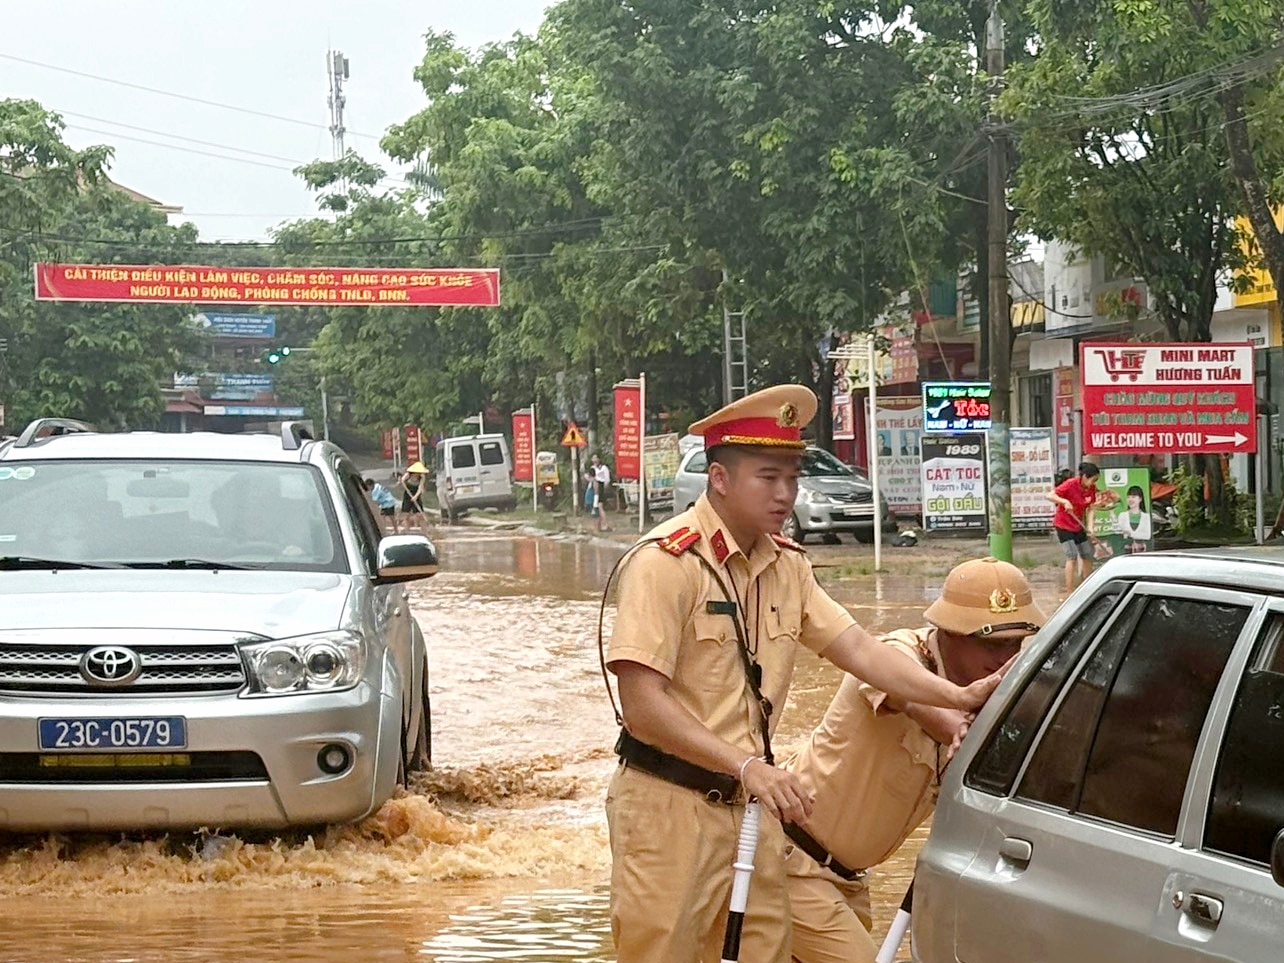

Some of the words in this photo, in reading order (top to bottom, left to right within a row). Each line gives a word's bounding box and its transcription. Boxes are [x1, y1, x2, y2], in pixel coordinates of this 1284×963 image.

[1161, 350, 1194, 363] MINI
[1197, 350, 1236, 363] MART
[1156, 368, 1203, 381] HƯƠNG
[1206, 366, 1241, 381] TUẤN
[1091, 432, 1154, 448] WELCOME
[1157, 432, 1174, 447] TO
[1178, 432, 1202, 447] YOU
[945, 445, 980, 456] 1989
[926, 465, 952, 481] CẮT
[932, 483, 955, 492] Nam
[55, 719, 171, 747] 23C-0579
